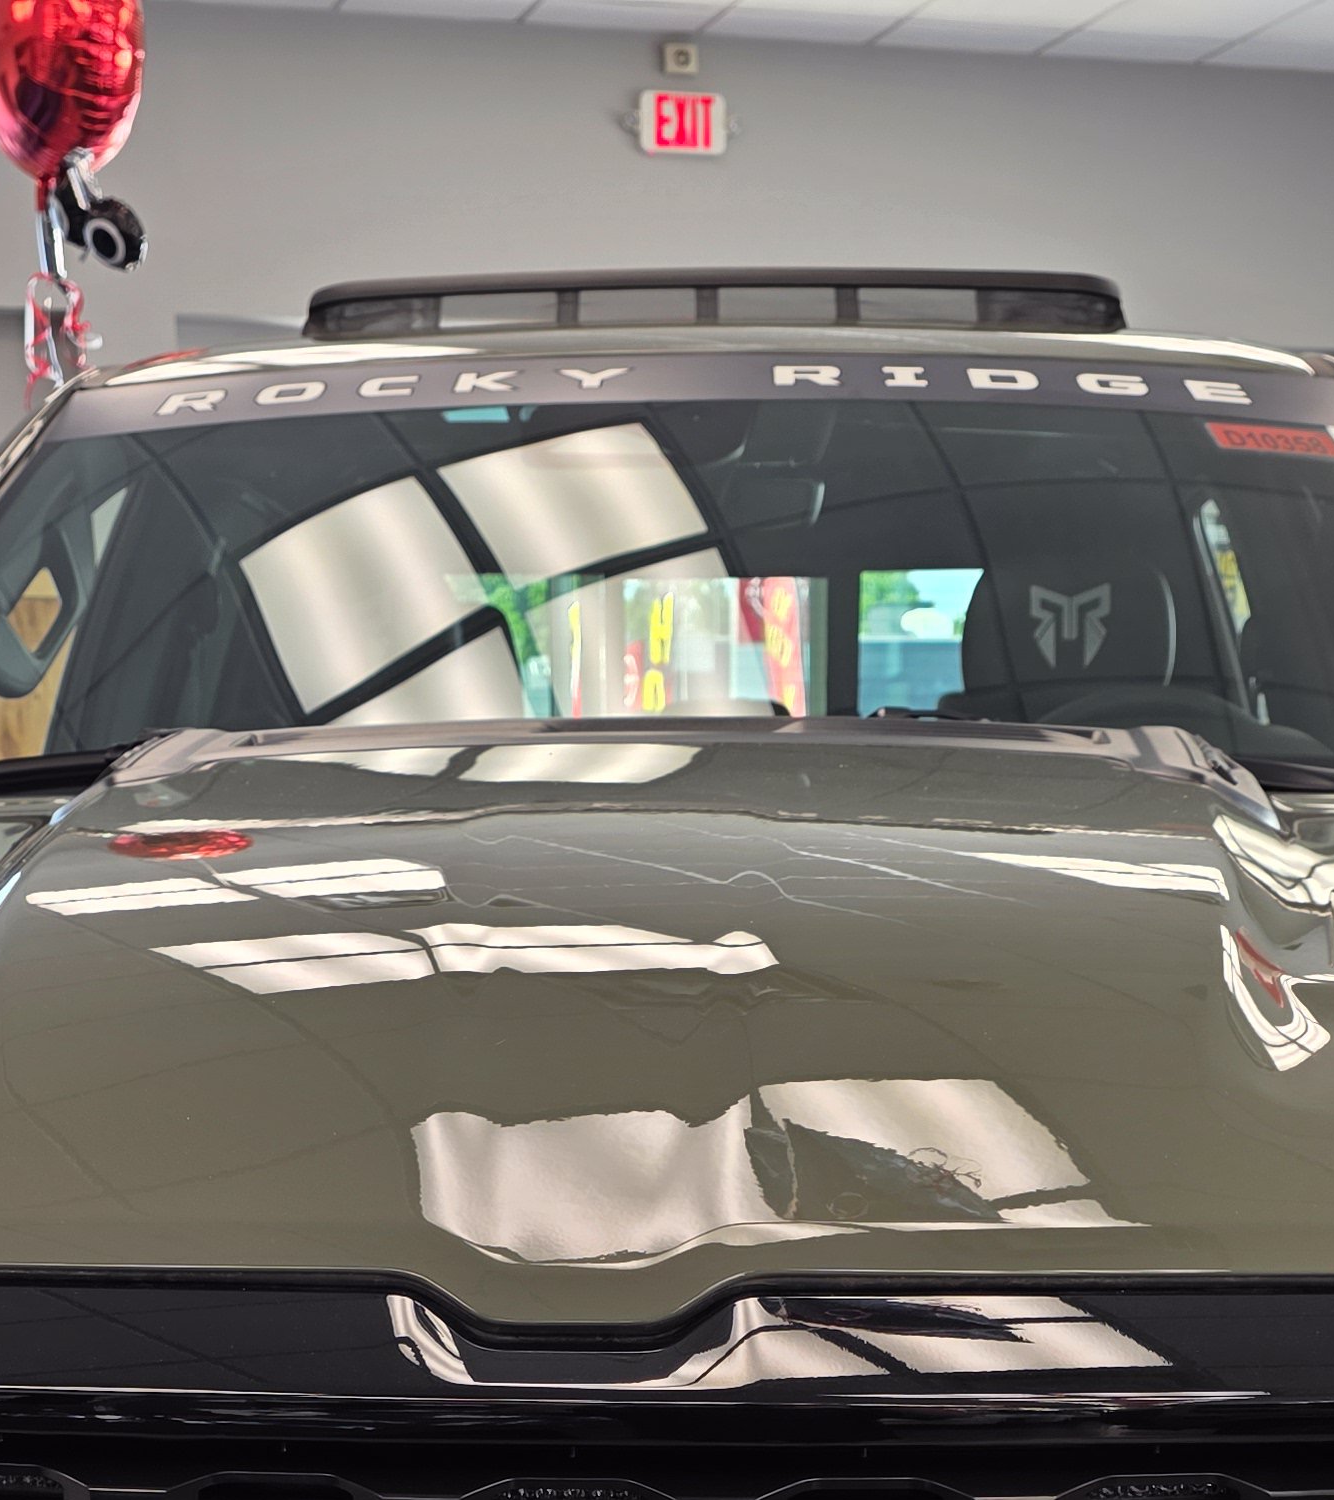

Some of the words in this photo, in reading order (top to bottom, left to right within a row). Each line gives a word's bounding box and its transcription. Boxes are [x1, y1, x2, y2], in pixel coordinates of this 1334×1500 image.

[654, 94, 714, 148] EXIT
[155, 367, 629, 417] ROCKY
[772, 364, 1253, 405] RIDGE
